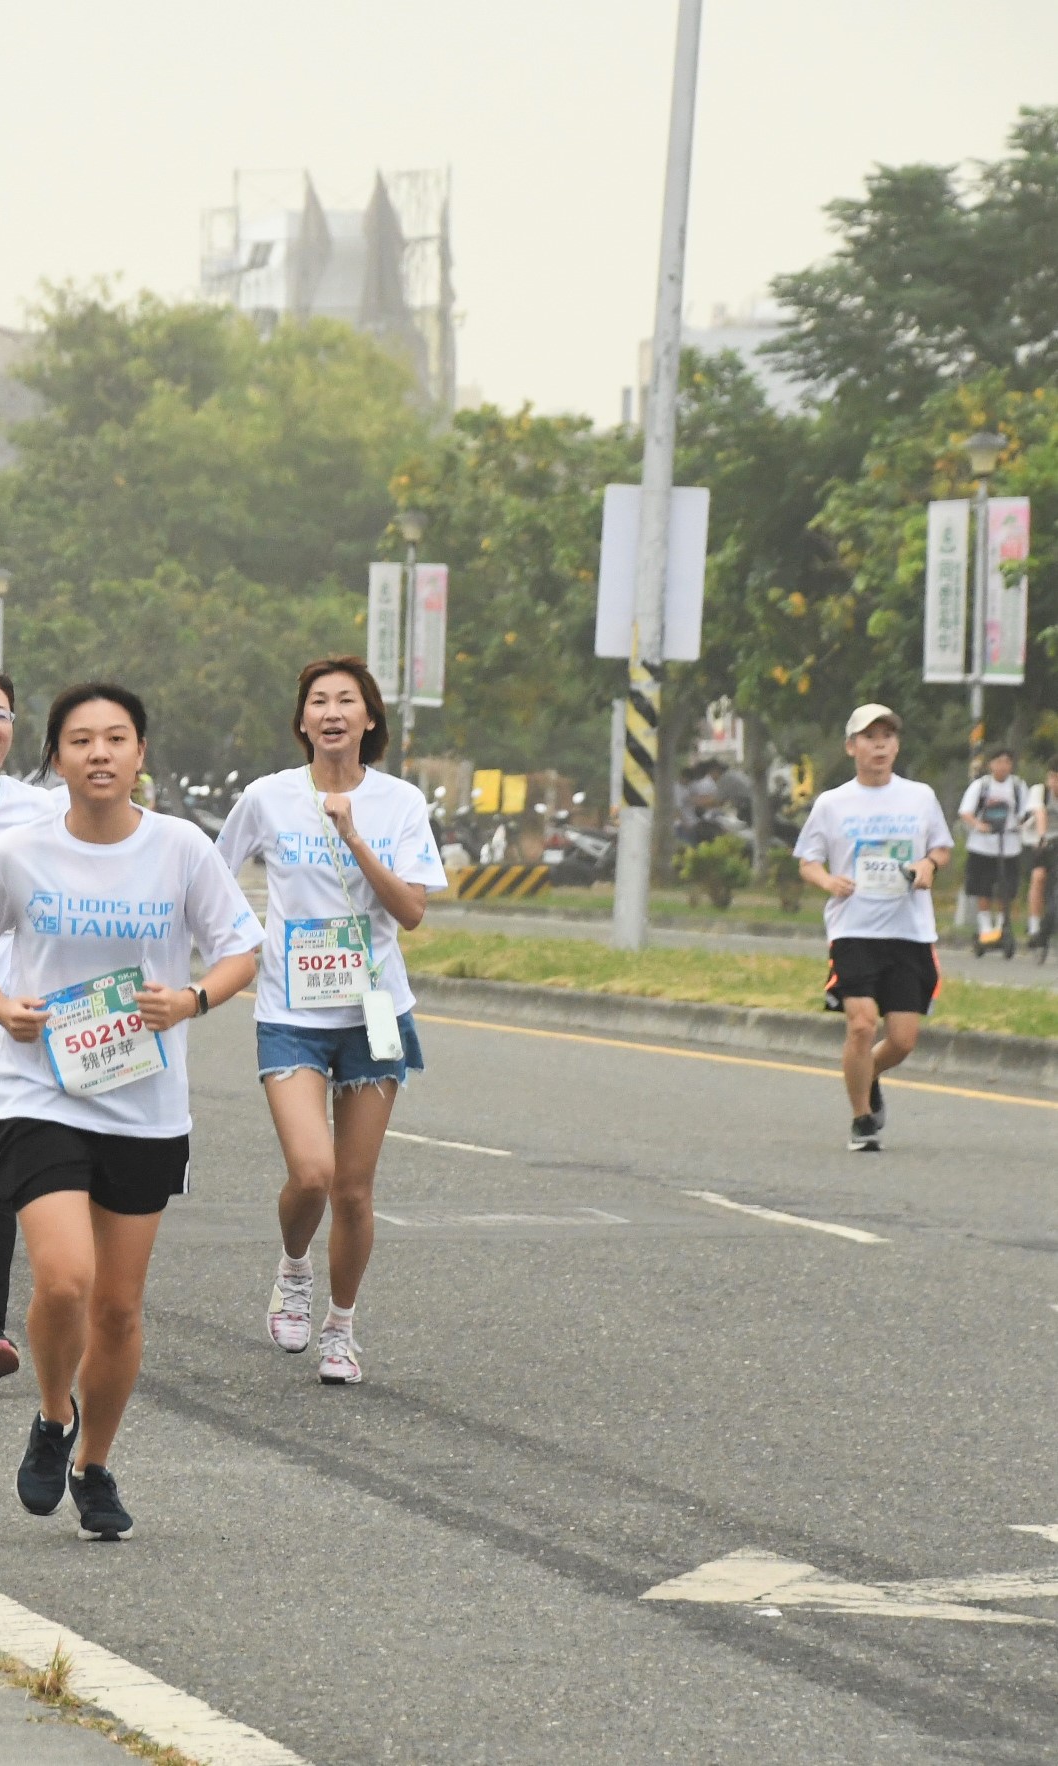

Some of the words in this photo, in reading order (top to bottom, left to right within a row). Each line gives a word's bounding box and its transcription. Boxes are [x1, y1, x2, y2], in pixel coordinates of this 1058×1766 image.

[67, 897, 131, 915] LIONS
[139, 901, 174, 916] CUP
[66, 917, 171, 940] TAIWAN
[298, 953, 362, 971] 50213
[65, 1014, 143, 1055] 50219
